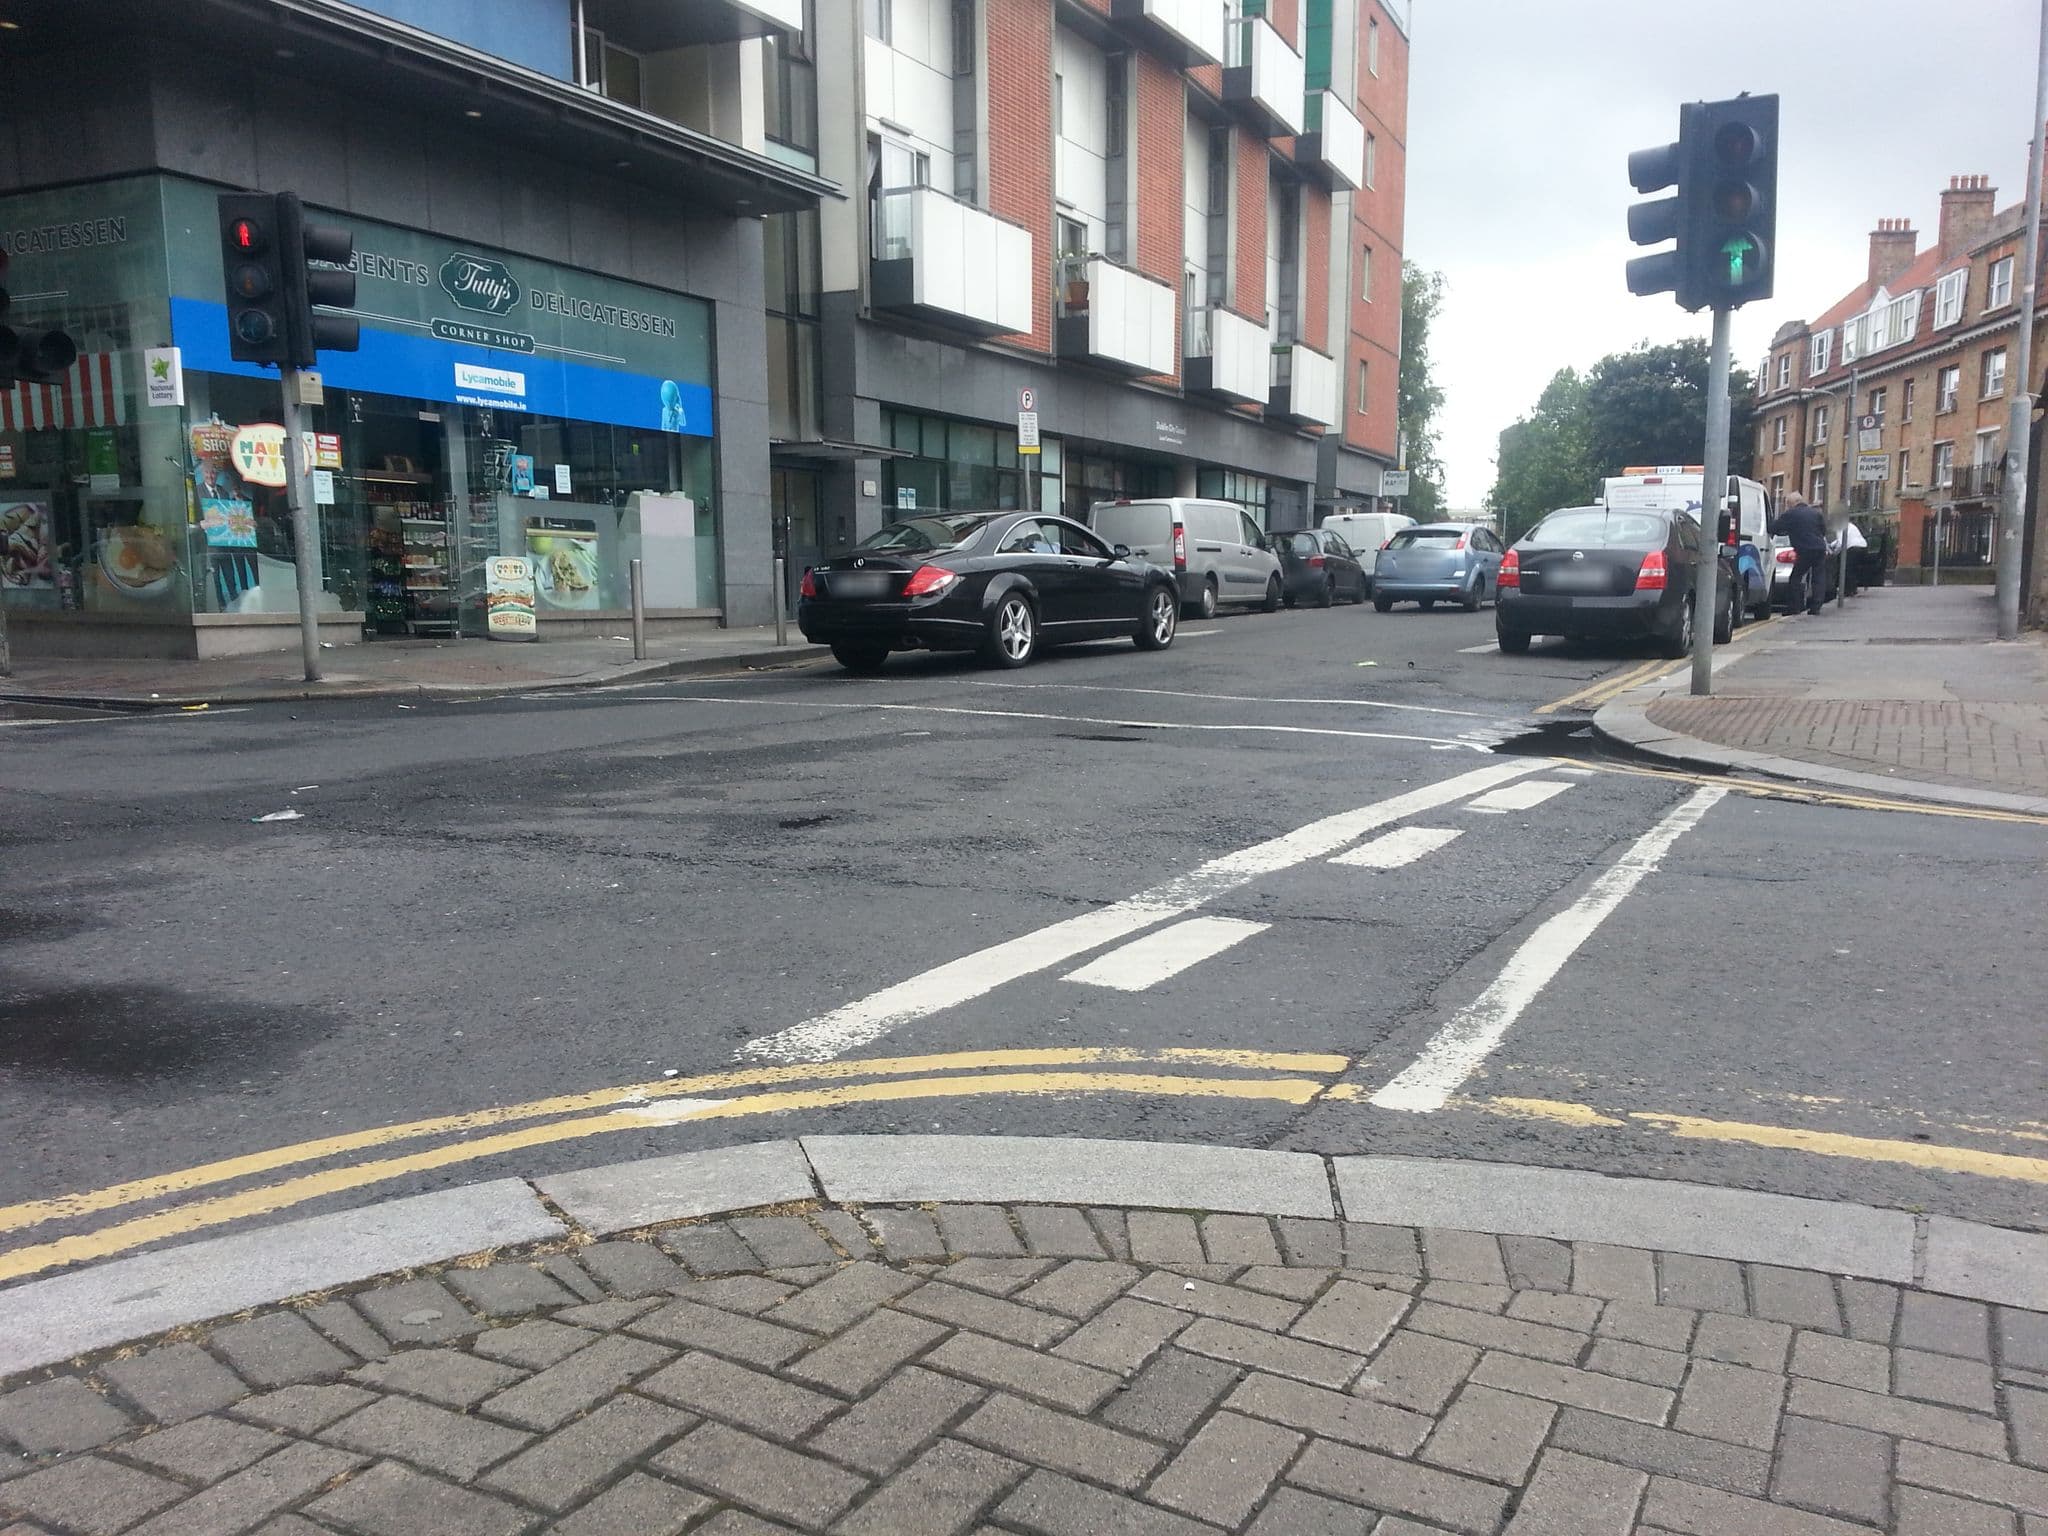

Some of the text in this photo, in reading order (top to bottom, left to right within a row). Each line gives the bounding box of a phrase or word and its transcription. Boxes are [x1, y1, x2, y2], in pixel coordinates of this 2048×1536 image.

[3, 216, 127, 256] ICATESSEN
[454, 259, 511, 310] Tutty's
[530, 288, 676, 338] DELICATESSEN
[440, 324, 526, 348] CORNER SHOP
[152, 391, 173, 400] Lottery
[462, 370, 516, 389] Lycamobile
